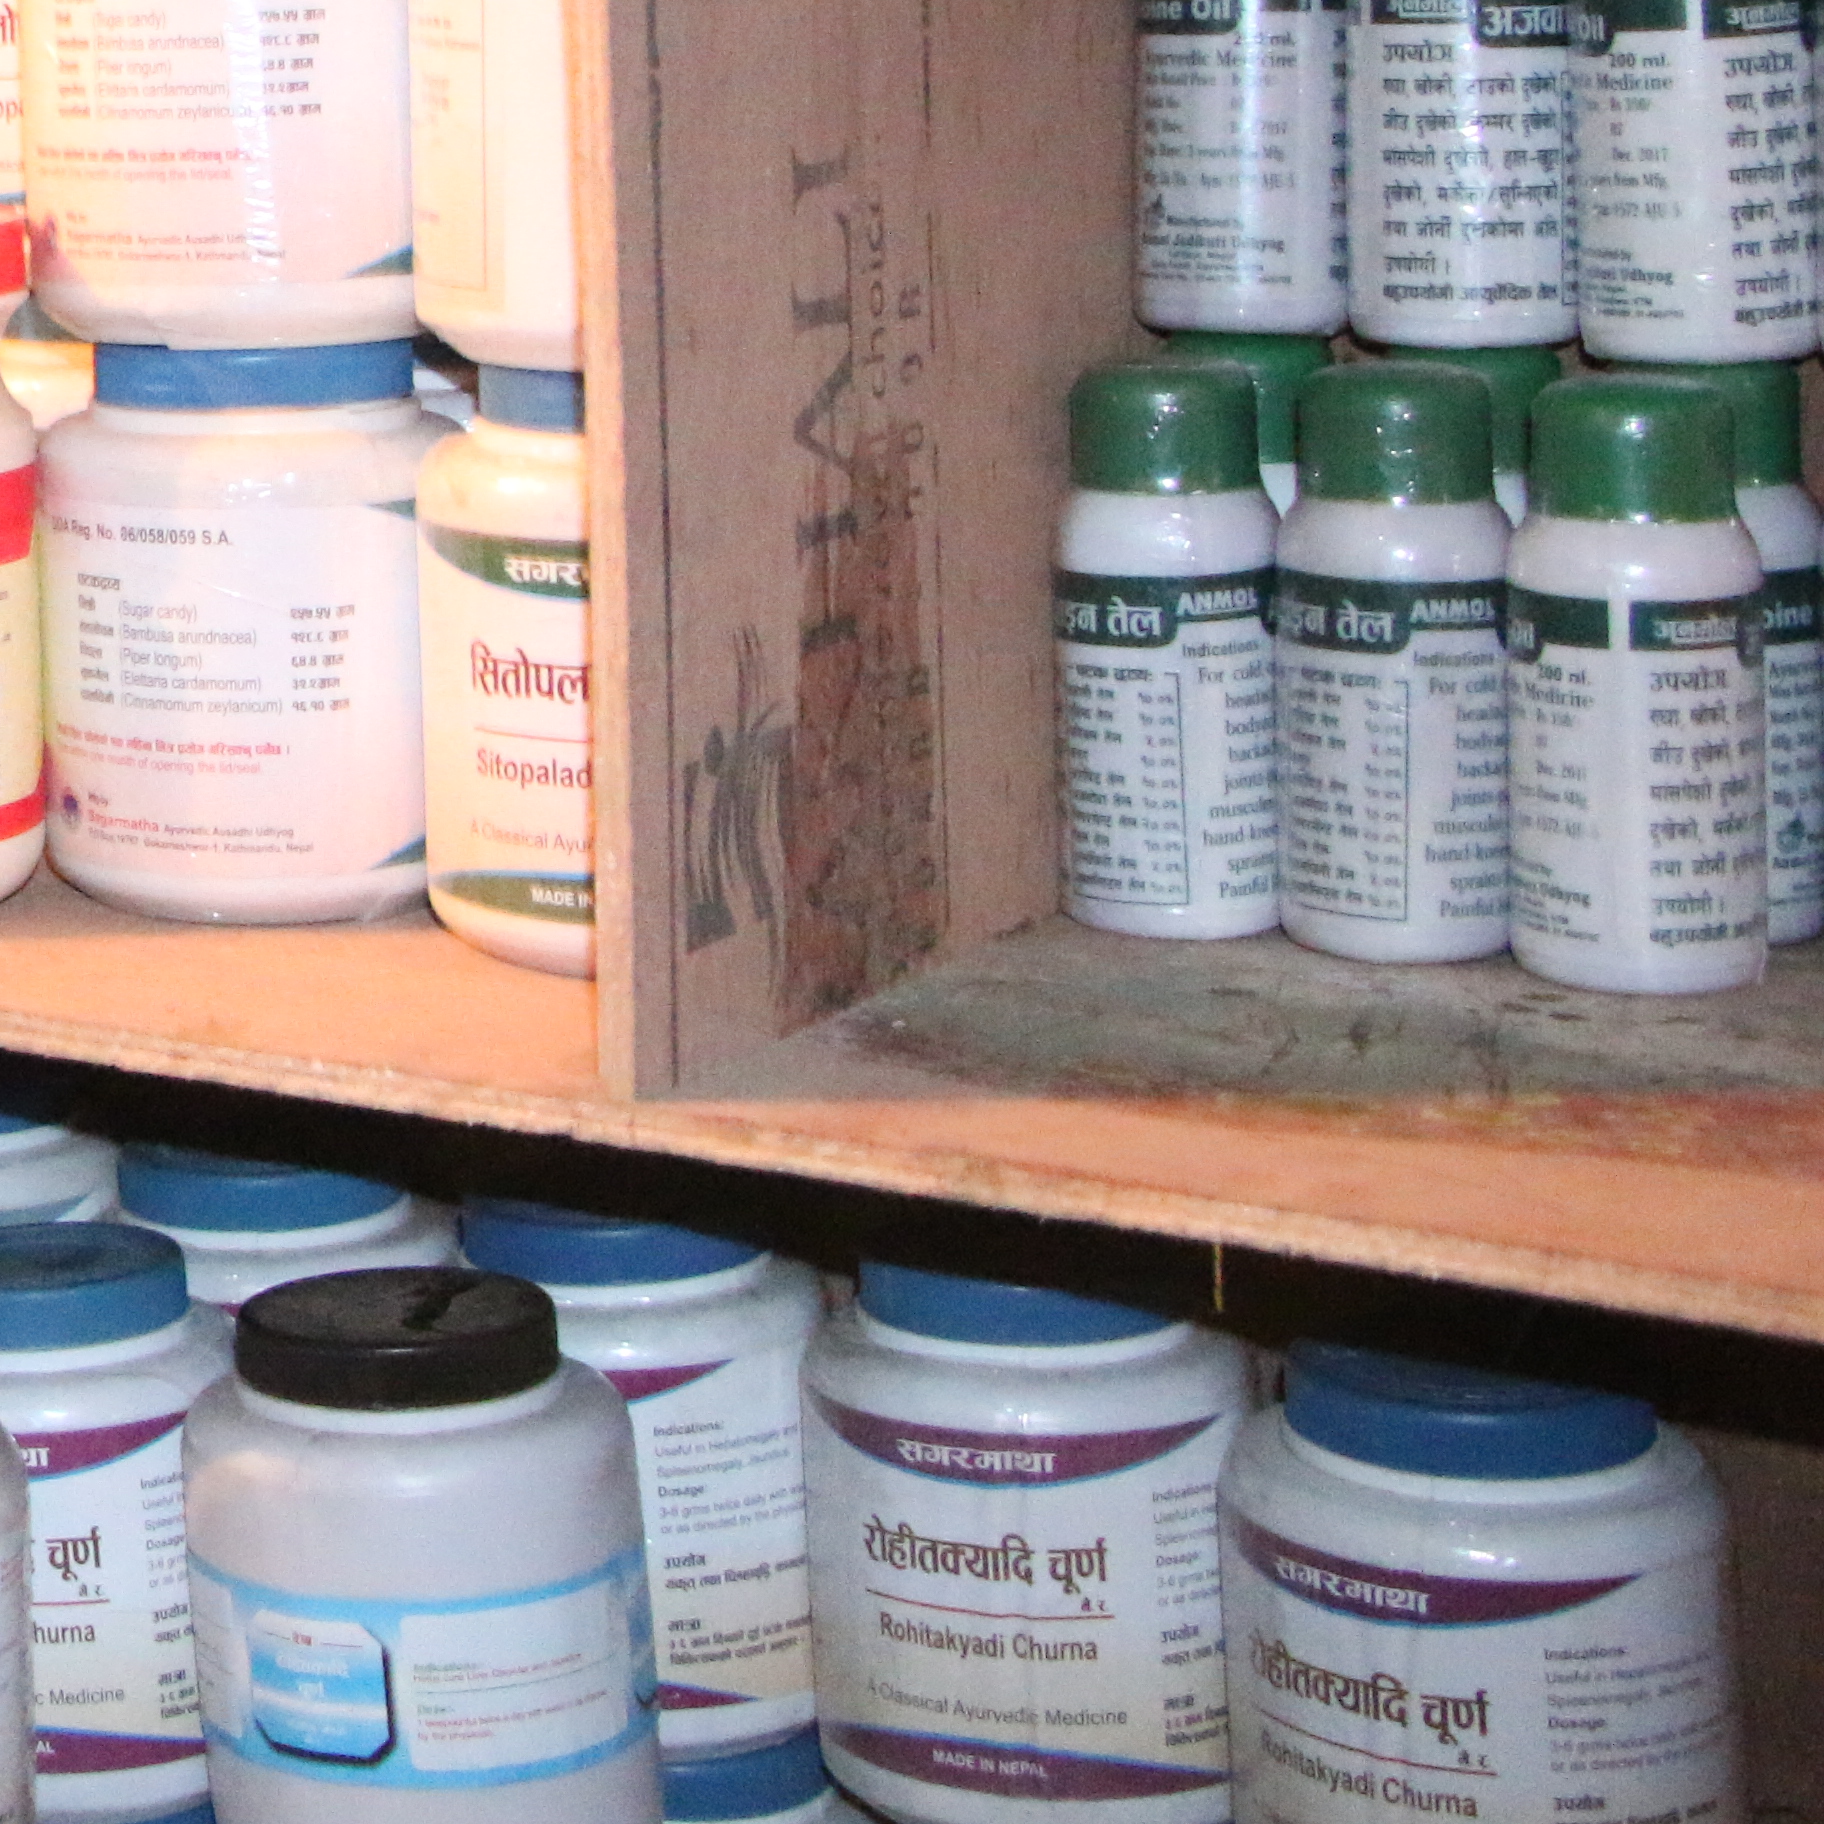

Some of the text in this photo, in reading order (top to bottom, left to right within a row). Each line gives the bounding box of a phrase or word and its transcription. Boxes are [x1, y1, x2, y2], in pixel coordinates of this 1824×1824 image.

[1610, 52, 1669, 69] 200 ml.
[1725, 50, 1793, 77] उपयोग
[1597, 76, 1674, 91] Medicine
[97, 523, 116, 541] No.
[201, 529, 233, 546] S.A.
[119, 600, 198, 622] (Sugar candy)
[1177, 588, 1258, 615] ANMOL
[1107, 594, 1162, 637] तेल
[1335, 598, 1394, 643] तेल
[119, 625, 257, 647] (Bambusa arundnacea)
[120, 648, 151, 666] (Piper
[171, 673, 262, 692] cardamomum)
[1198, 667, 1224, 684] For
[1650, 668, 1728, 692] उपयोग
[206, 696, 283, 715] zeylanicum)
[151, 759, 194, 777] opening
[88, 808, 159, 833] Sagarmatha
[531, 887, 574, 907] MADE
[655, 1442, 692, 1458] Useful
[896, 1437, 1057, 1474] सगरमाथा
[45, 1526, 102, 1581] चूर्ण
[863, 1513, 1109, 1595] रोहीतक्यादि चूर्ण
[1274, 1555, 1431, 1615] सगरमाथा
[880, 1610, 1098, 1662] Rohitakyadi Churna
[50, 1687, 124, 1705] Medicine
[1249, 1627, 1490, 1746] रोहीतक्यादि चूर्ण
[878, 1679, 948, 1715] Classical
[952, 1699, 1038, 1728] Ayurvedic
[1045, 1707, 1128, 1727] Medicine
[932, 1747, 1047, 1777] MADE IN NEPAL
[1260, 1727, 1479, 1818] Rohitakyadi Churna
